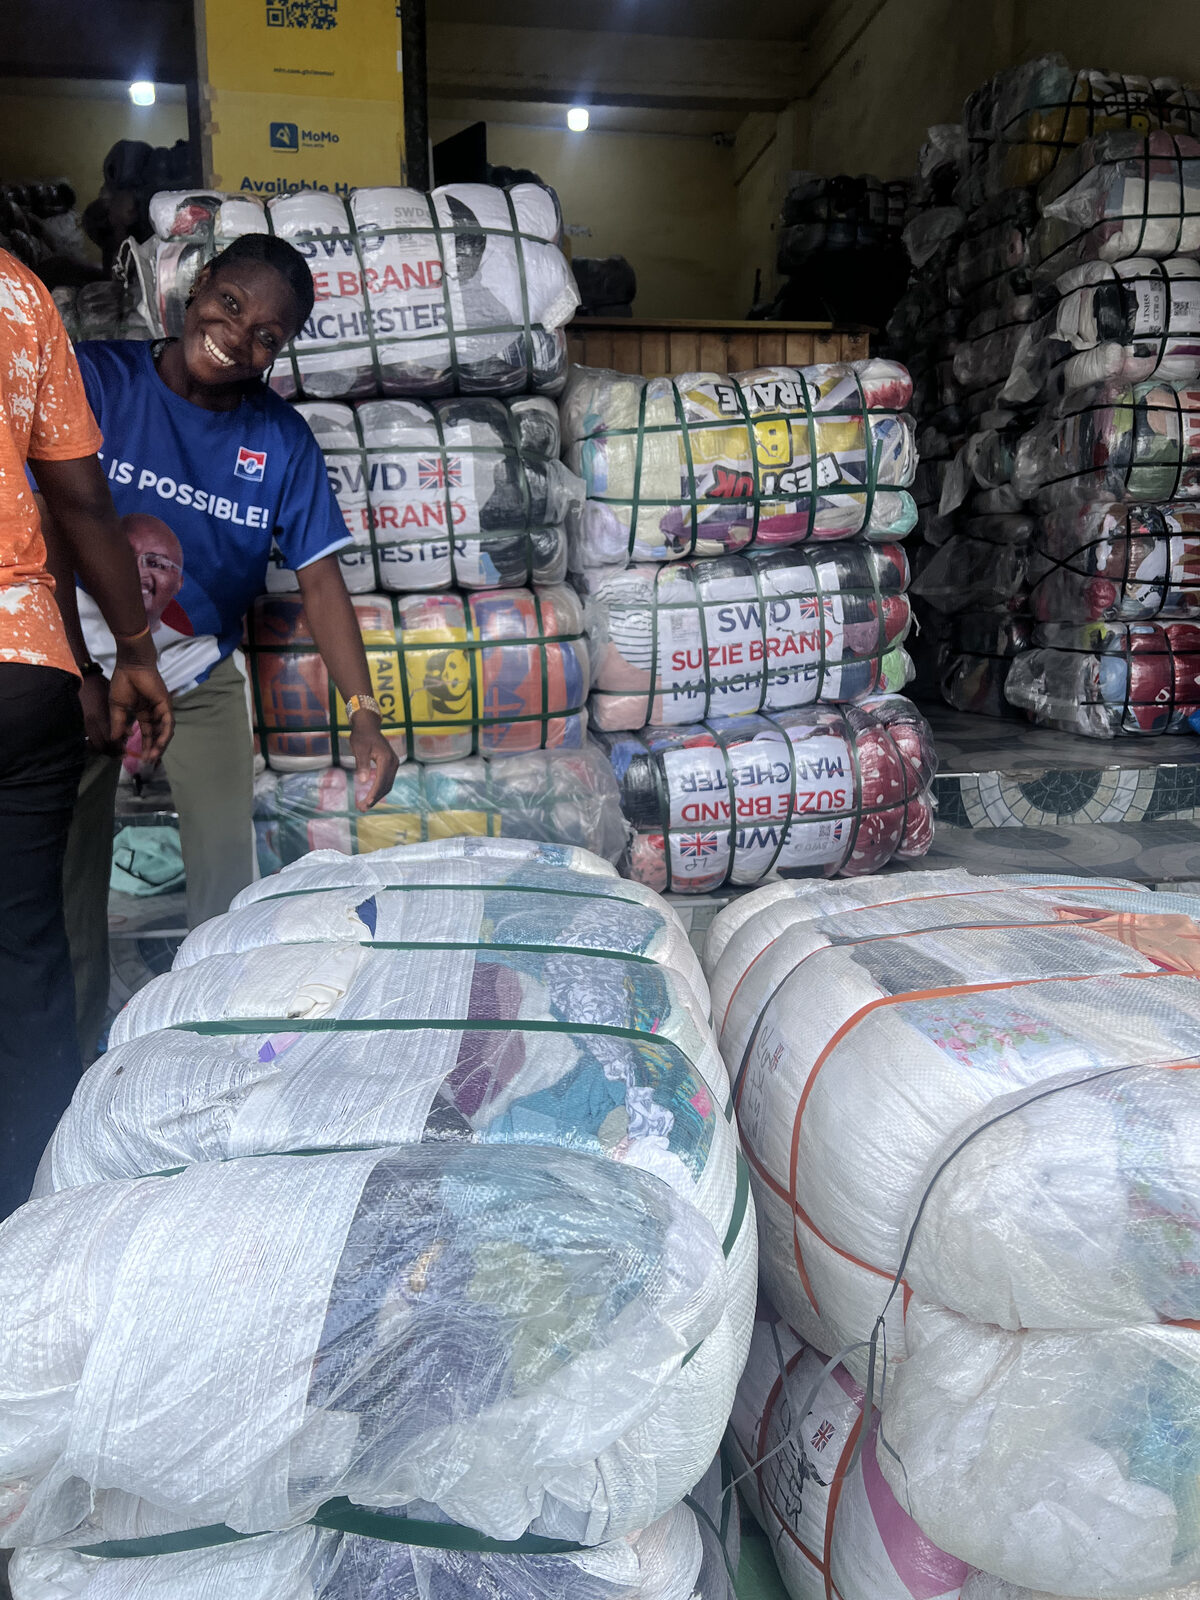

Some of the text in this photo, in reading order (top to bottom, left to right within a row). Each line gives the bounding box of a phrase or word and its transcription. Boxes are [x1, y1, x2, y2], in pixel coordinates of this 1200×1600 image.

[302, 130, 339, 143] MoMo
[240, 176, 329, 193] Available
[295, 223, 385, 258] SWD
[337, 260, 444, 296] BRAND
[297, 303, 448, 341] NCHESTER
[108, 459, 269, 529] IS POSSIBLE!
[326, 463, 407, 494] SWD
[708, 455, 841, 498] BEST UK
[360, 501, 467, 530] BRAND
[718, 600, 791, 632] SWD
[672, 629, 834, 671] SUZIE BRAND
[672, 662, 831, 700] MANCHSTE
[681, 756, 845, 792] MANCHESTER
[681, 789, 846, 822] SUZIE BRAND
